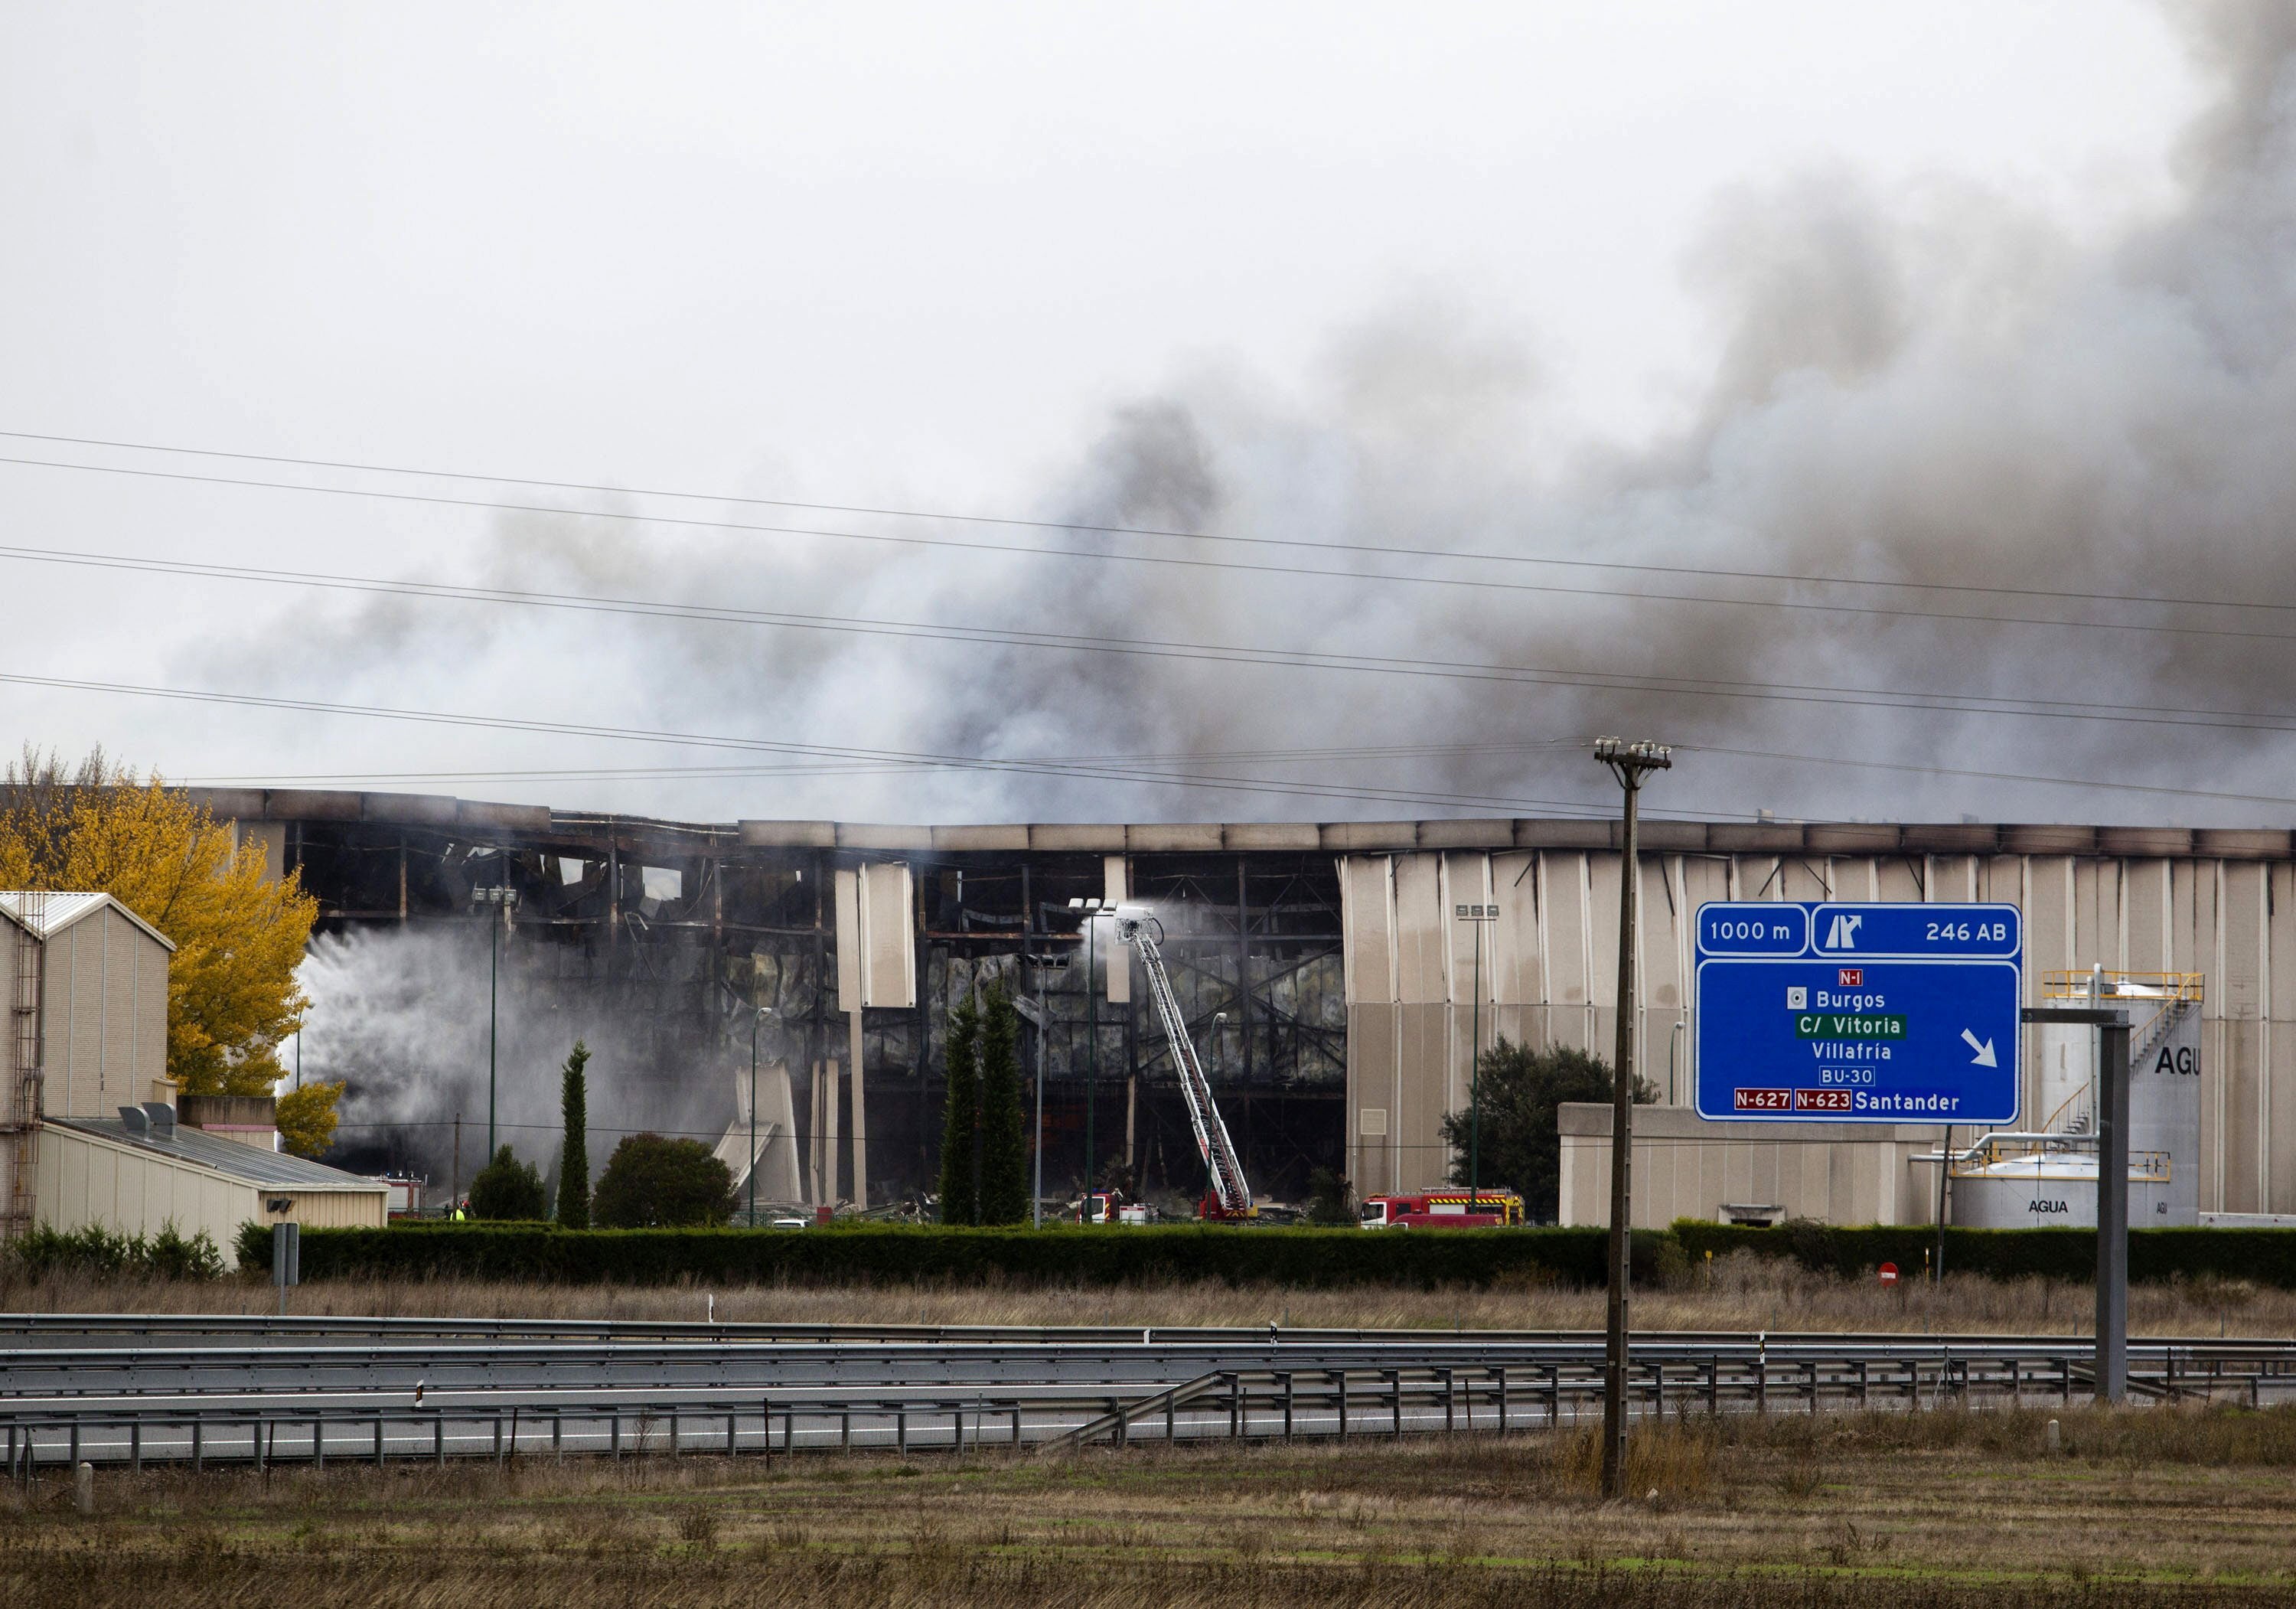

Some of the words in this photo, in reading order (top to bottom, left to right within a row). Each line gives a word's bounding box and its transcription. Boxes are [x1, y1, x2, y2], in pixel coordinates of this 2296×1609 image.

[1711, 922, 1765, 940] 1000
[1773, 926, 1790, 939] m
[1926, 922, 1970, 941] 246
[1976, 923, 2006, 942] AB
[1817, 991, 1885, 1012] Burgos
[1800, 1017, 1821, 1033] C/
[1833, 1017, 1900, 1034] Vitoria
[1812, 1042, 1891, 1060] Villafría
[2154, 1046, 2201, 1075] AGU
[1822, 1069, 1872, 1083] BU-30
[1737, 1092, 1789, 1107] N-627
[1797, 1092, 1850, 1108] N-623
[1855, 1092, 1960, 1111] Santander
[2028, 1200, 2069, 1214] AGUA
